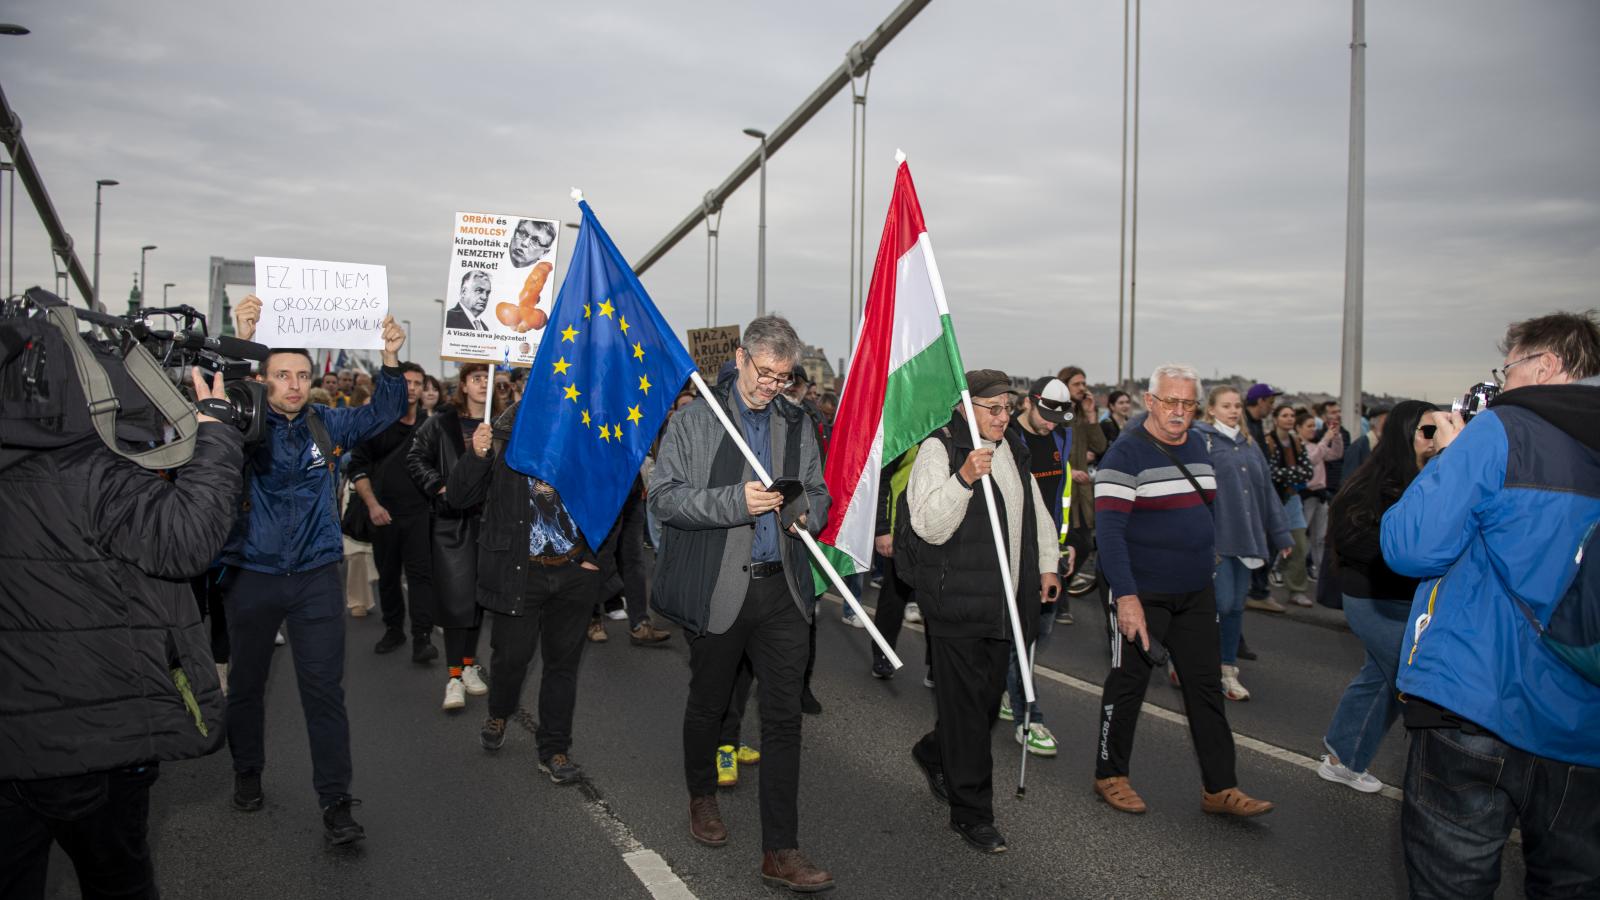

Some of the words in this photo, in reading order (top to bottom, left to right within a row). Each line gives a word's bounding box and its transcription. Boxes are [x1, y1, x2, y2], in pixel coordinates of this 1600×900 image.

[462, 214, 494, 224] ORBÁN
[496, 216, 507, 225] és
[460, 226, 507, 236] MATOLCSY
[455, 236, 501, 248] kirabolták
[503, 241, 509, 249] a
[456, 248, 505, 259] NEMZETHY
[461, 259, 499, 270] BANKot!
[266, 265, 292, 289] EZ
[302, 268, 329, 291] ITT
[335, 271, 370, 289] NEM
[272, 292, 381, 312] OROSZORSZÁG
[453, 330, 476, 338] Viszkis
[693, 329, 732, 344] HAZA-
